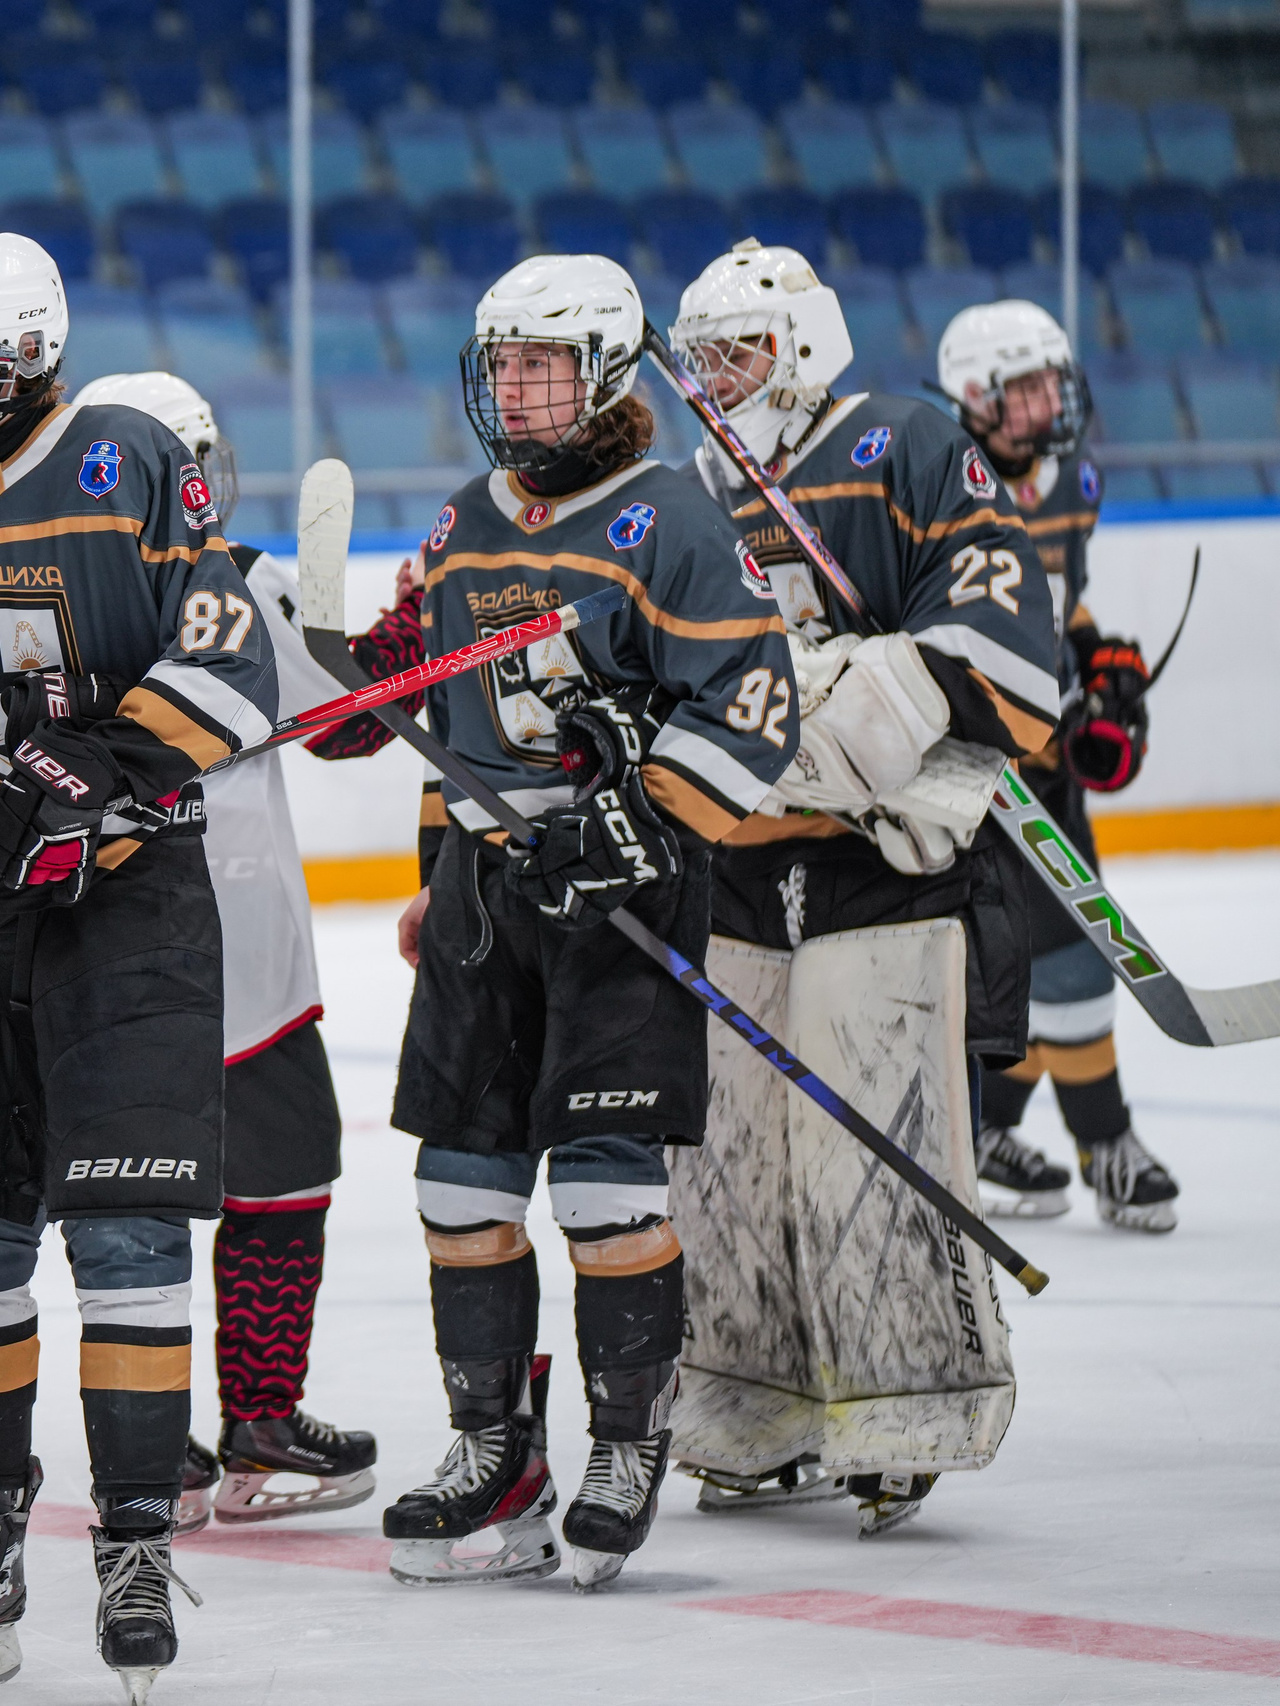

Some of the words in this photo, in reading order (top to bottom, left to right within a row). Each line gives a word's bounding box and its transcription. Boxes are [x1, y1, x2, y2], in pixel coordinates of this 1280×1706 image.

[18, 307, 48, 320] CCM
[947, 543, 1022, 616] 22
[180, 590, 254, 654] 87
[725, 667, 791, 750] 92
[14, 739, 90, 803] UER
[567, 1089, 660, 1111] CCM
[65, 1157, 198, 1182] BAUER
